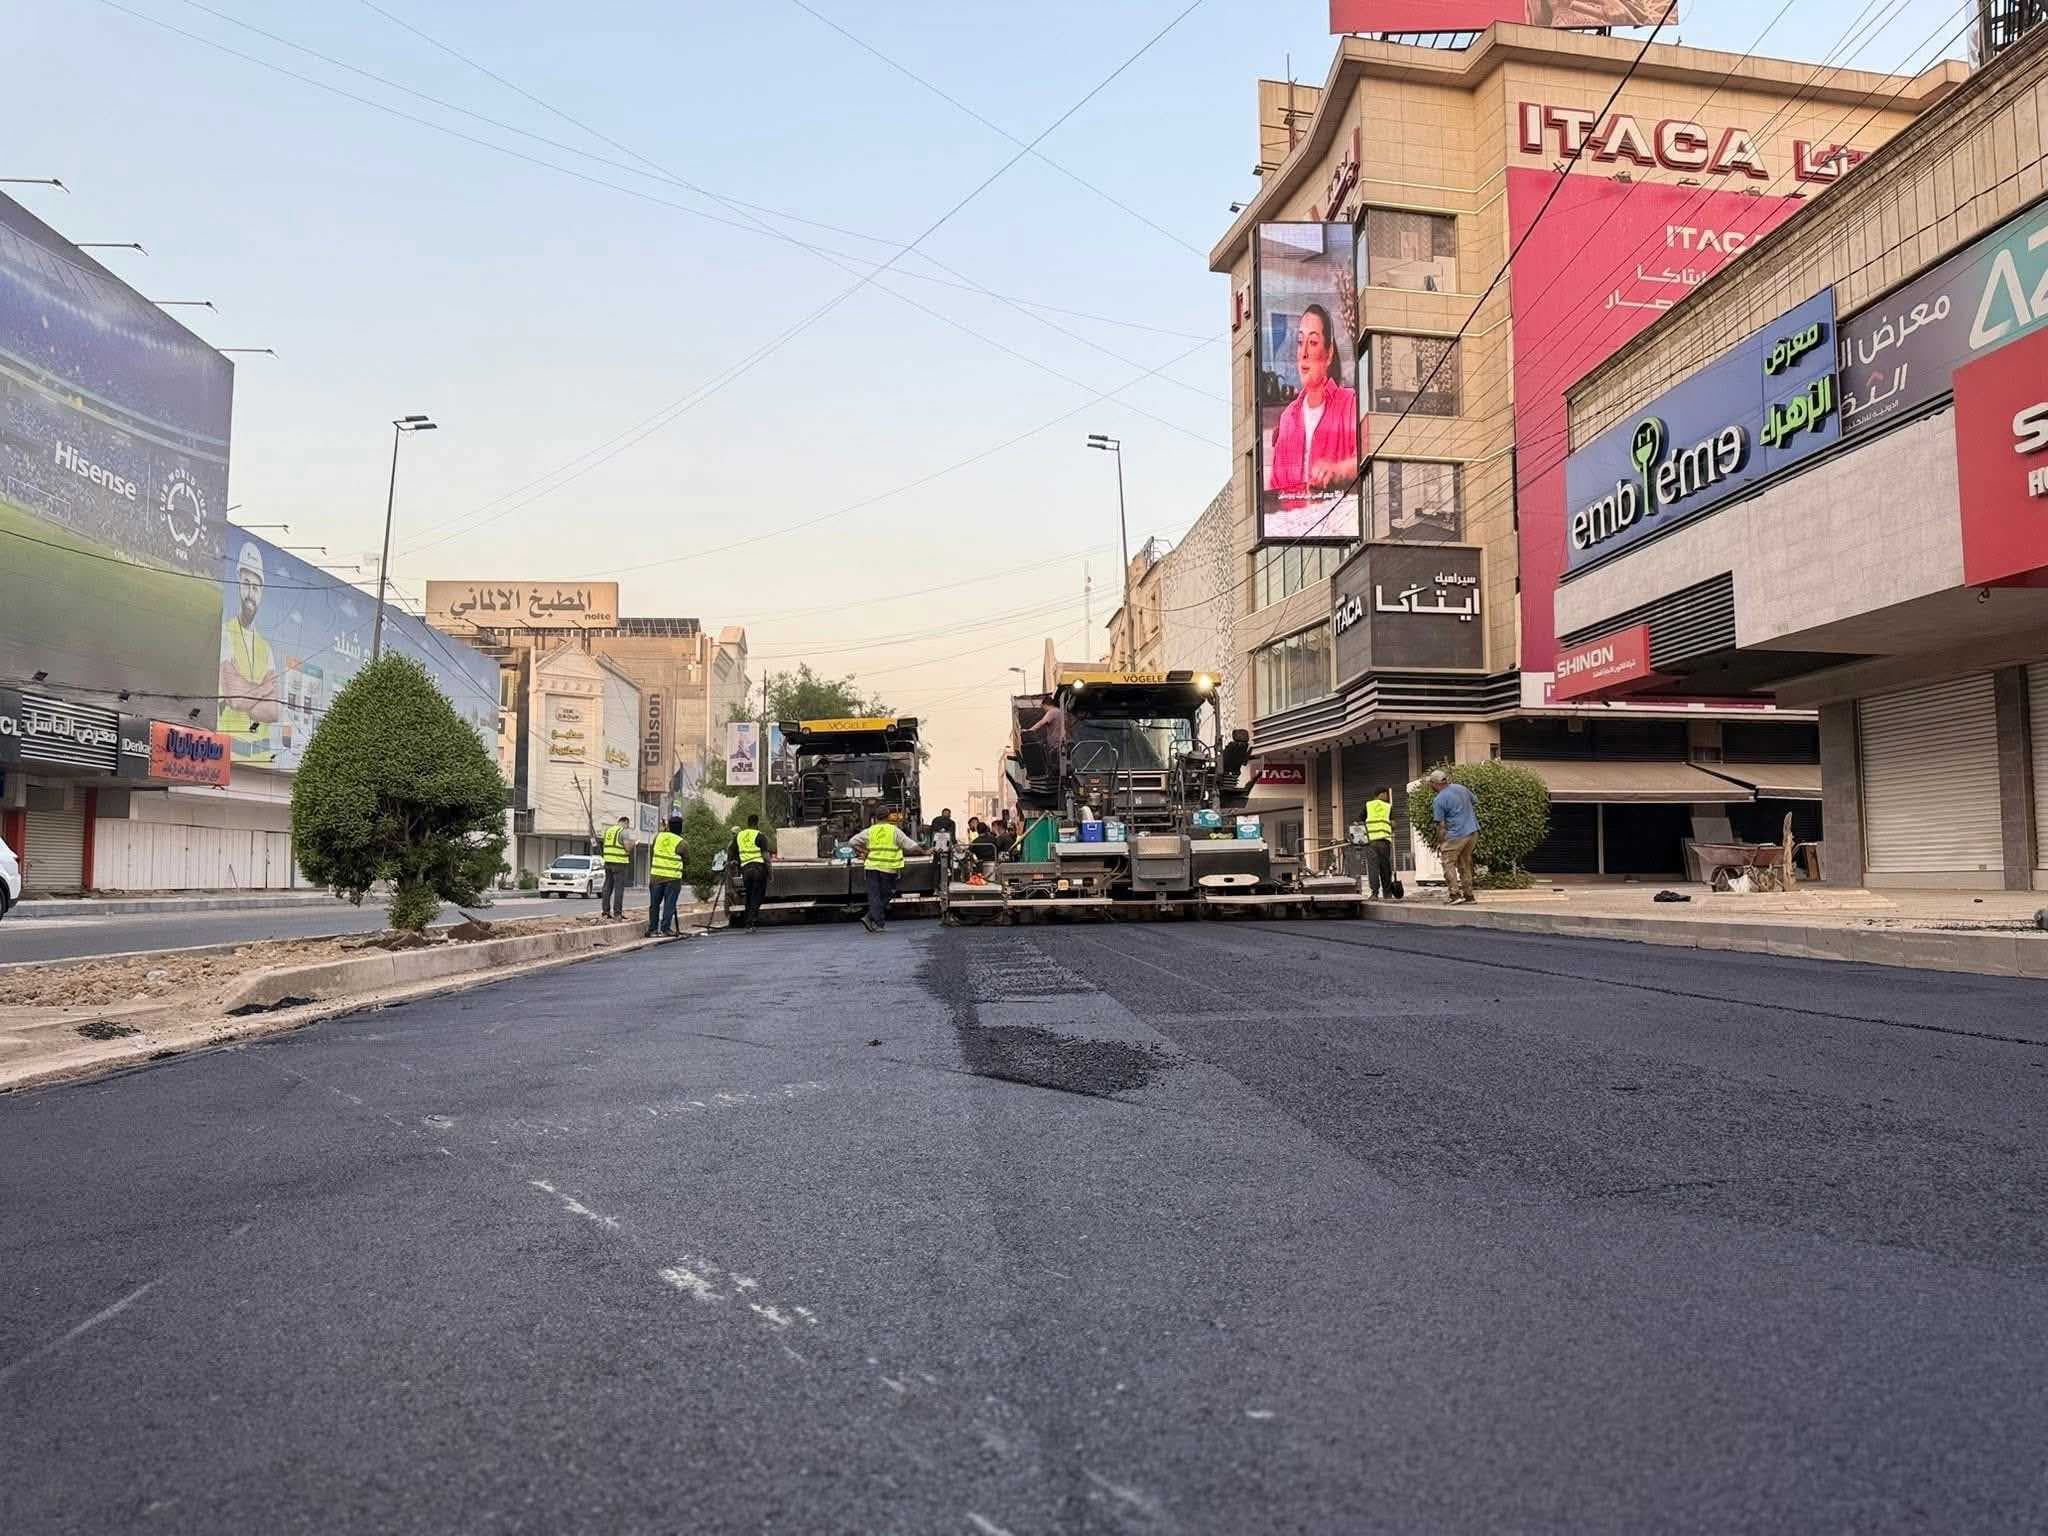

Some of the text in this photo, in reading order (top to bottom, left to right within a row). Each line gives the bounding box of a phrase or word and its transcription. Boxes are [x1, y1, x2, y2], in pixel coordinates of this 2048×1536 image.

[1519, 101, 1769, 180] ITACA
[1764, 322, 1821, 376] معرض
[1858, 295, 1951, 364] معرض
[1759, 376, 1832, 449] الزهراء
[55, 440, 137, 501] Hisense
[450, 587, 592, 620] المطبخ الالماني
[1333, 594, 1363, 637] ITACA
[1375, 583, 1481, 621] ايتاكا
[1556, 644, 1615, 680] SHINON
[0, 715, 22, 736] CL
[644, 693, 661, 767] Gibson
